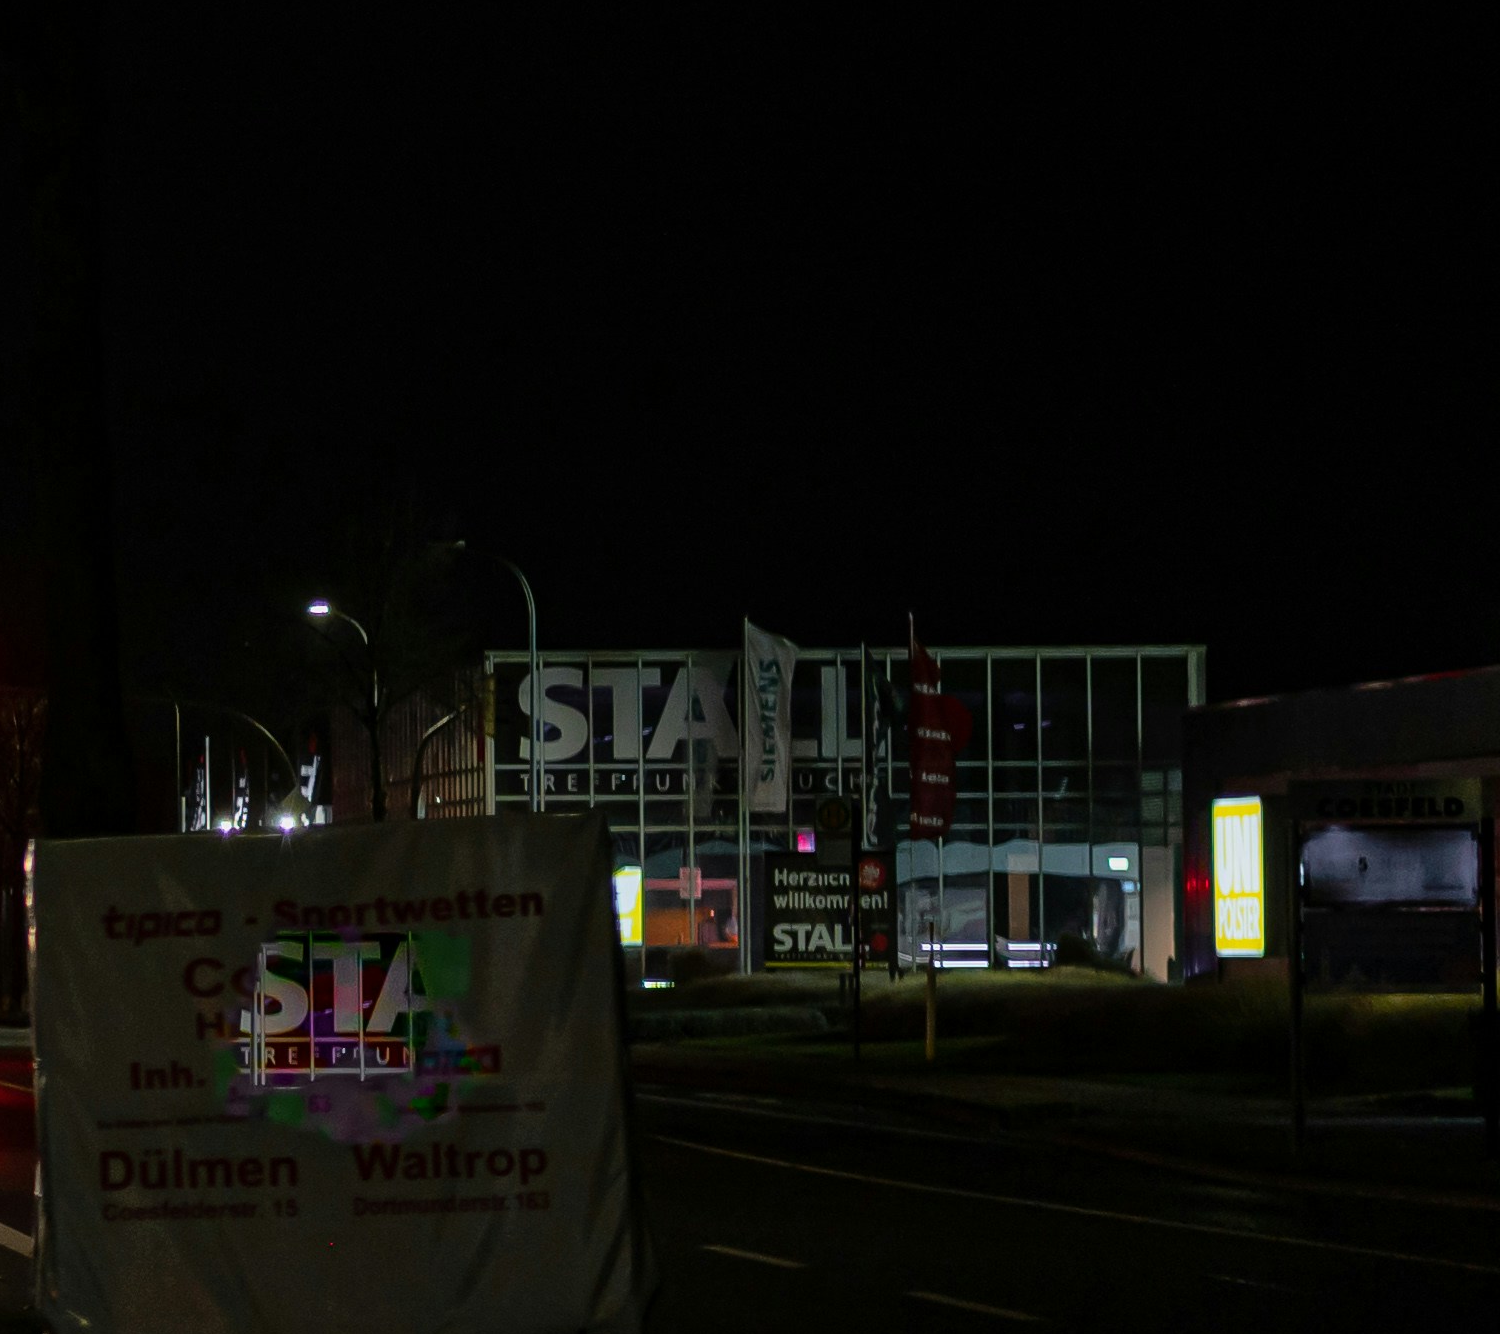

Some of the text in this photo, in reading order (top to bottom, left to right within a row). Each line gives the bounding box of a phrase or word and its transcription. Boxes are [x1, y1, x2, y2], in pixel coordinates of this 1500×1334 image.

[759, 660, 780, 782] SIEMENS
[1318, 796, 1465, 817] COESFELD
[1215, 814, 1260, 896] UNI
[773, 891, 889, 909] willkomen!
[1218, 898, 1260, 940] POLSTER
[103, 905, 221, 946] tipico
[130, 1062, 206, 1089] Inh.
[100, 1142, 548, 1191] Dülmen Waltrop
